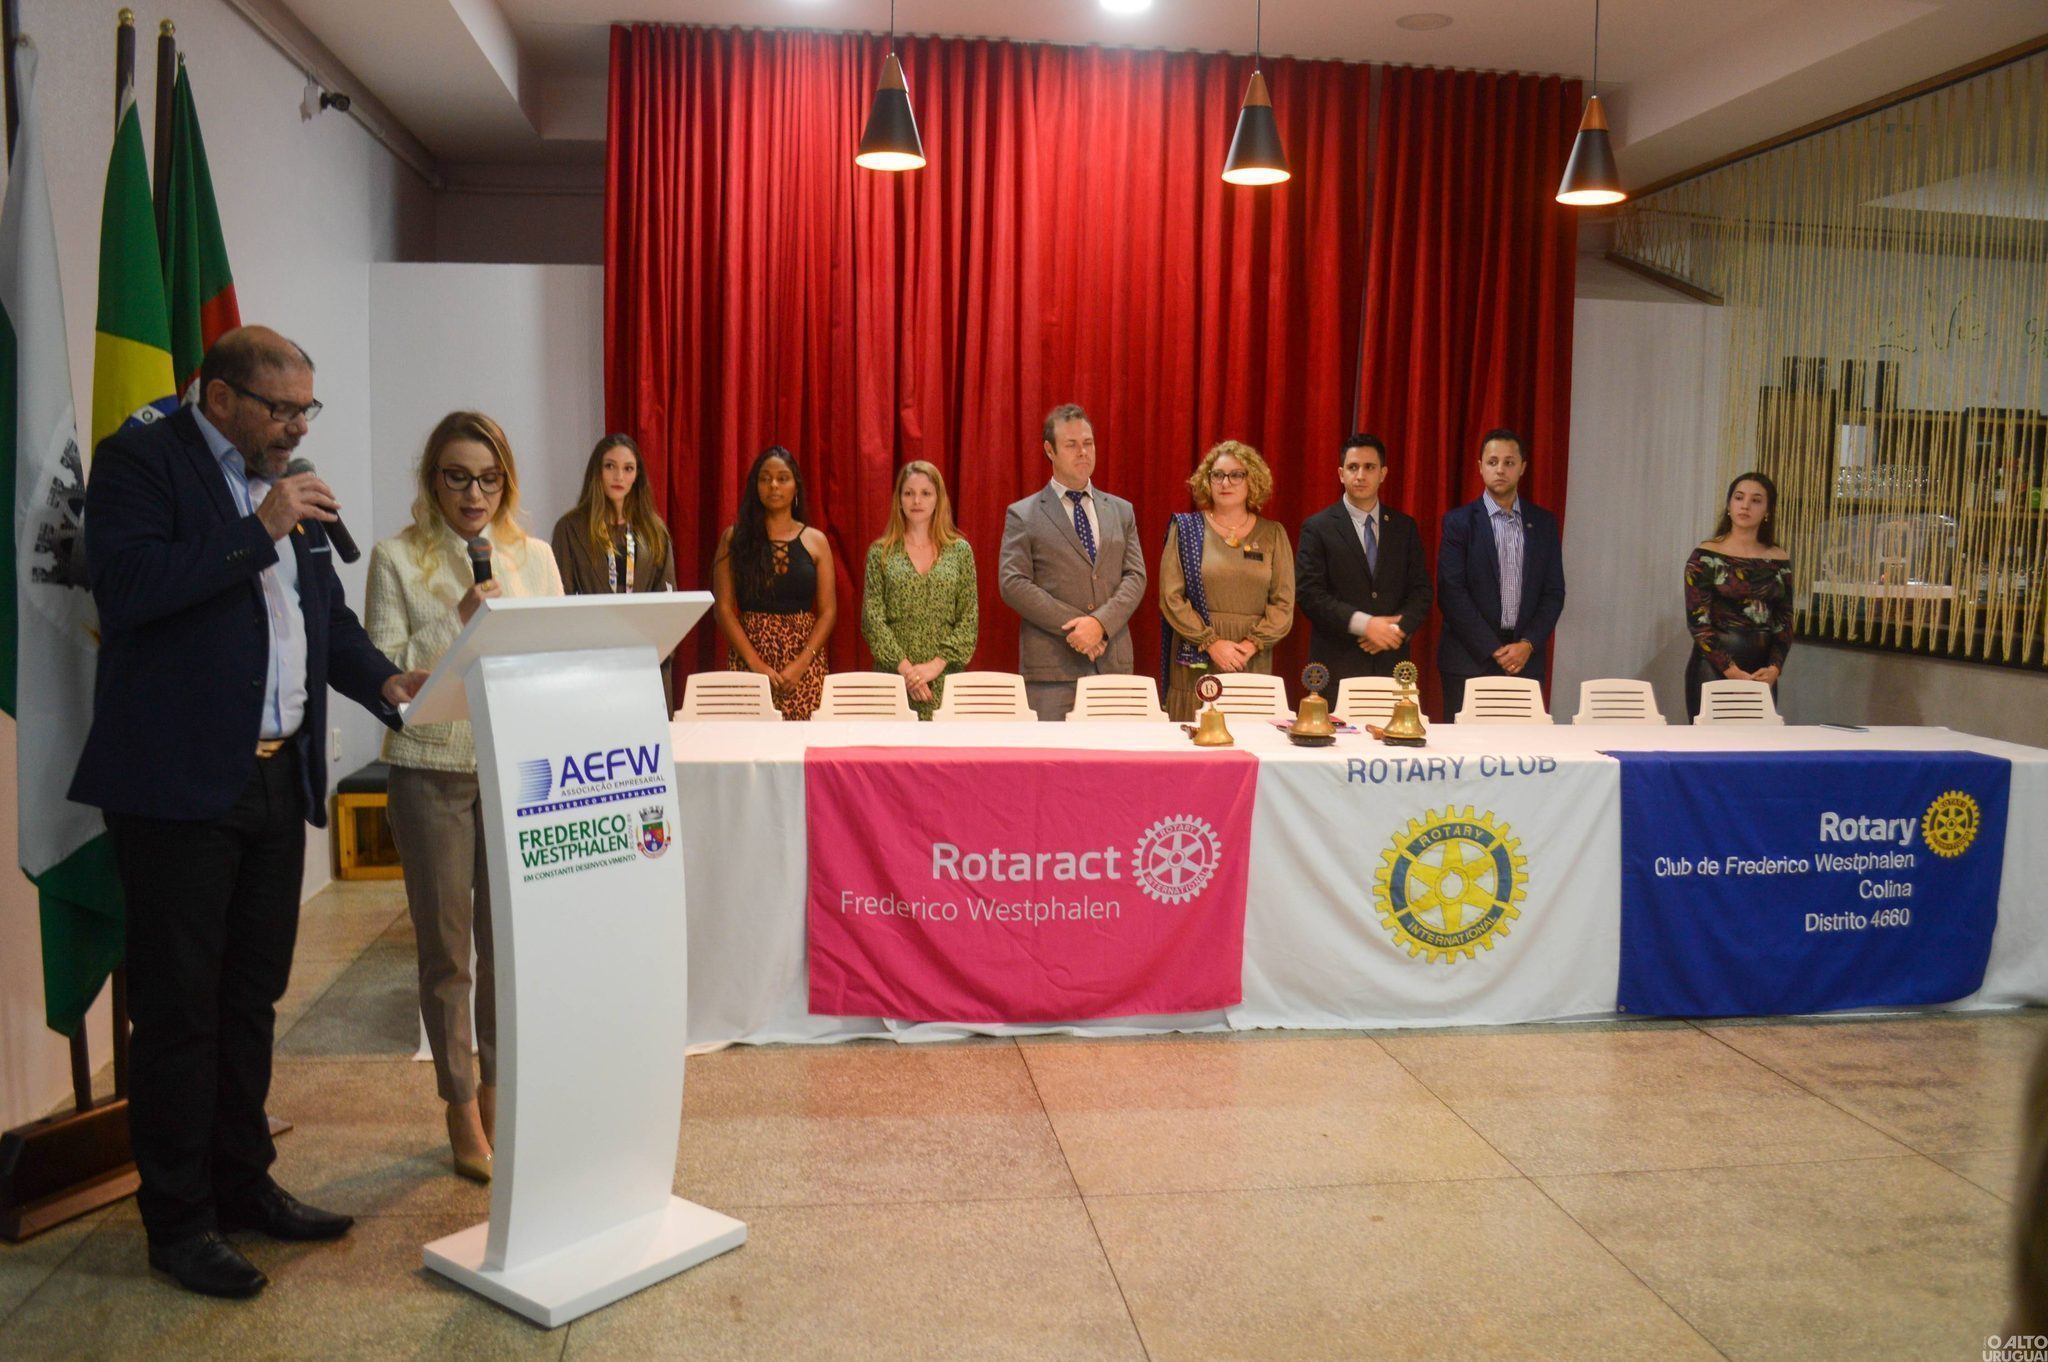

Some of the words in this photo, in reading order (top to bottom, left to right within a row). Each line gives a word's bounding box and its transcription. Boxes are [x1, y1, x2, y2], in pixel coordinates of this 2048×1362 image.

[560, 744, 660, 788] AEFW
[1347, 756, 1464, 784] ROTARY
[1480, 755, 1557, 777] CLUB
[561, 781, 612, 797] ASSOCIAÇÃO
[615, 775, 664, 788] EMPRESARIAL
[519, 814, 626, 850] FREDERICO
[1160, 824, 1196, 837] ROTARY
[1419, 826, 1484, 848] ROTARY
[1820, 811, 1917, 846] Rotary
[521, 834, 629, 868] WESTPHALEN
[932, 843, 1122, 882] Rotaract
[1654, 856, 1693, 876] Club
[1697, 856, 1719, 875] de
[1725, 856, 1809, 875] Frederico
[1814, 850, 1915, 875] Westphalen
[523, 873, 534, 882] EM
[535, 866, 574, 880] CONSTANTE
[575, 854, 637, 872] DESENVOLVIMENTO
[1859, 879, 1912, 899] Colina
[841, 890, 958, 921] Frederico
[966, 895, 1121, 926] Westphalen
[1805, 911, 1867, 932] Distrito
[1870, 908, 1910, 928] 4660
[1407, 914, 1499, 946] INTERNATIONAL
